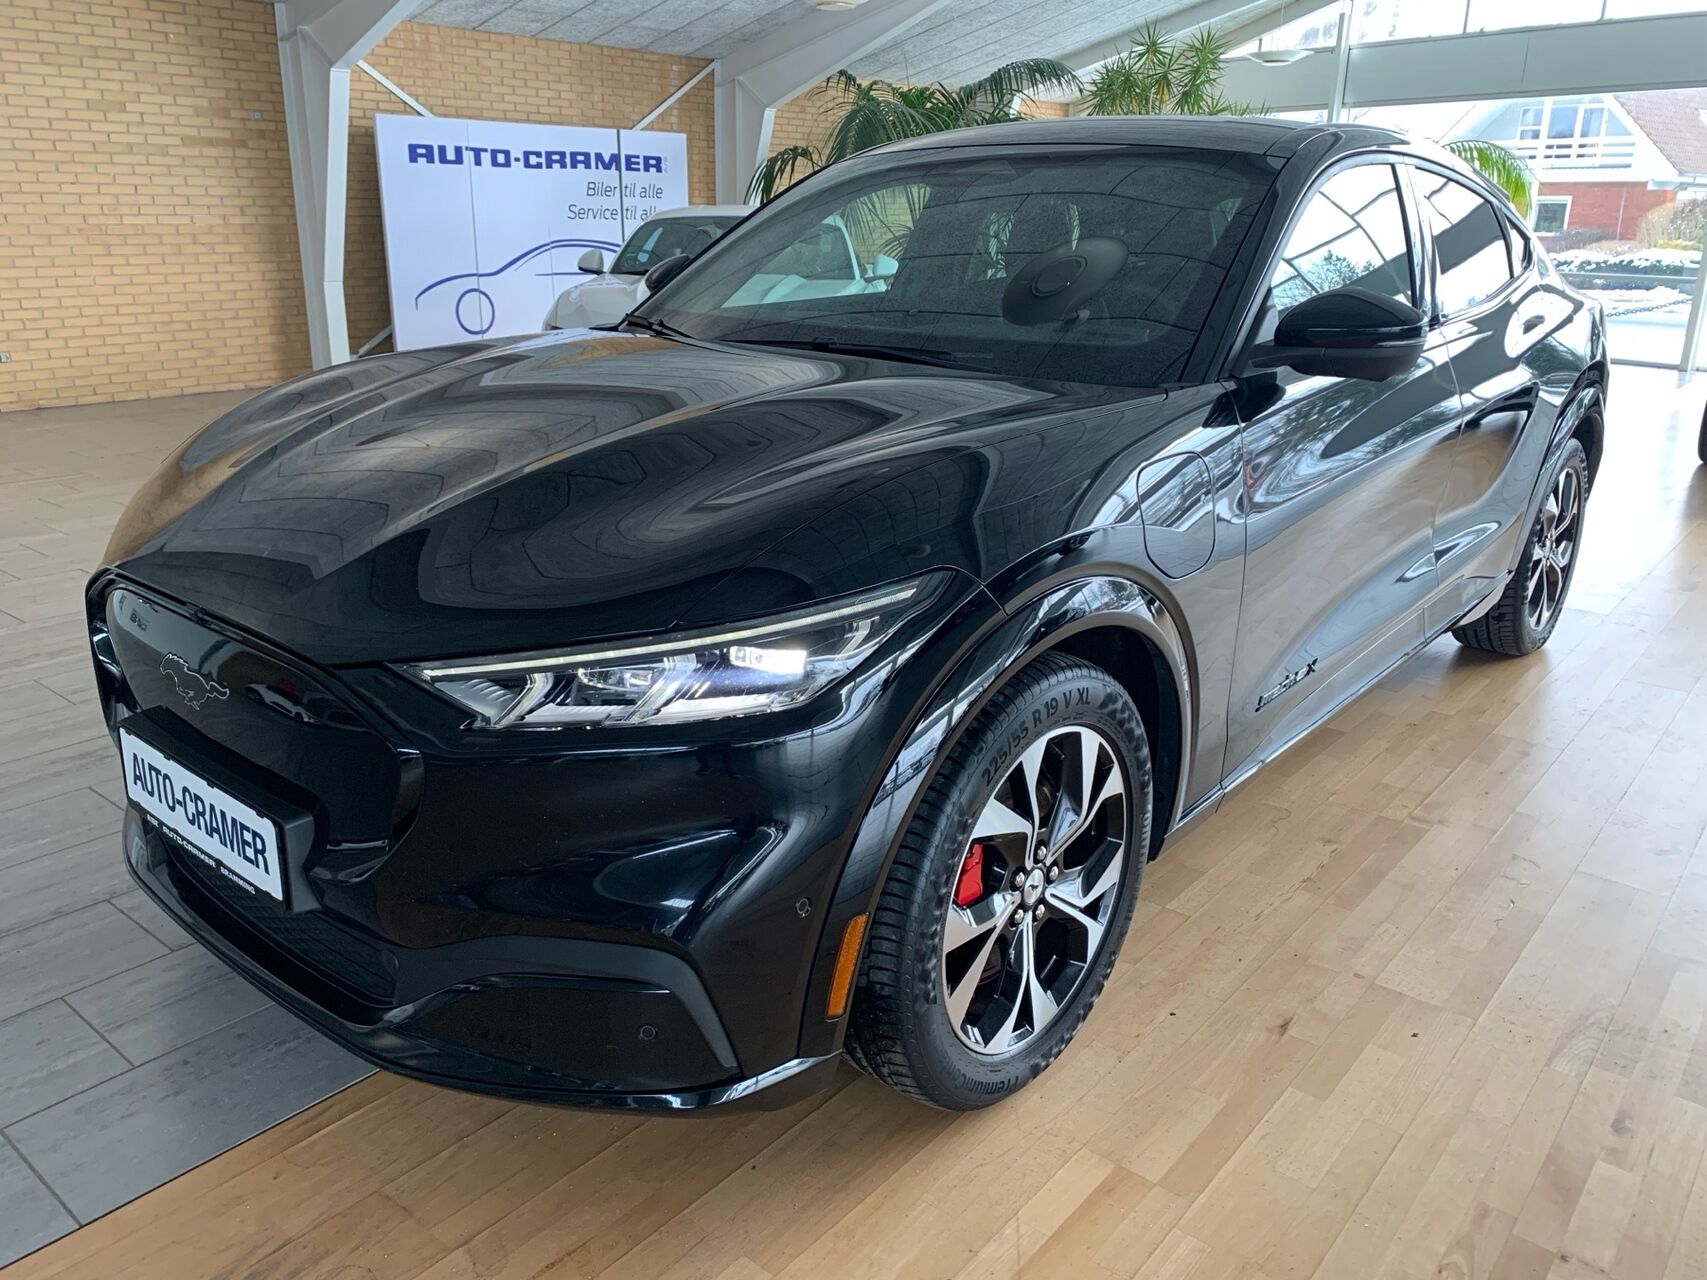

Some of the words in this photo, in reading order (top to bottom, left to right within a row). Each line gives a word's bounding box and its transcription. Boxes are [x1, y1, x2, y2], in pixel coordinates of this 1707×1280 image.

[408, 143, 663, 173] AUTO-CRAMER
[586, 181, 618, 198] Biler
[624, 182, 636, 198] til
[640, 184, 663, 199] alle
[567, 204, 618, 220] Service
[625, 205, 637, 220] til
[982, 721, 1029, 787] 225/55
[1032, 708, 1042, 728] R
[1044, 697, 1058, 719] 19
[1063, 690, 1072, 709] V
[1076, 687, 1090, 706] XL
[132, 752, 271, 876] AUTO-CRAMER
